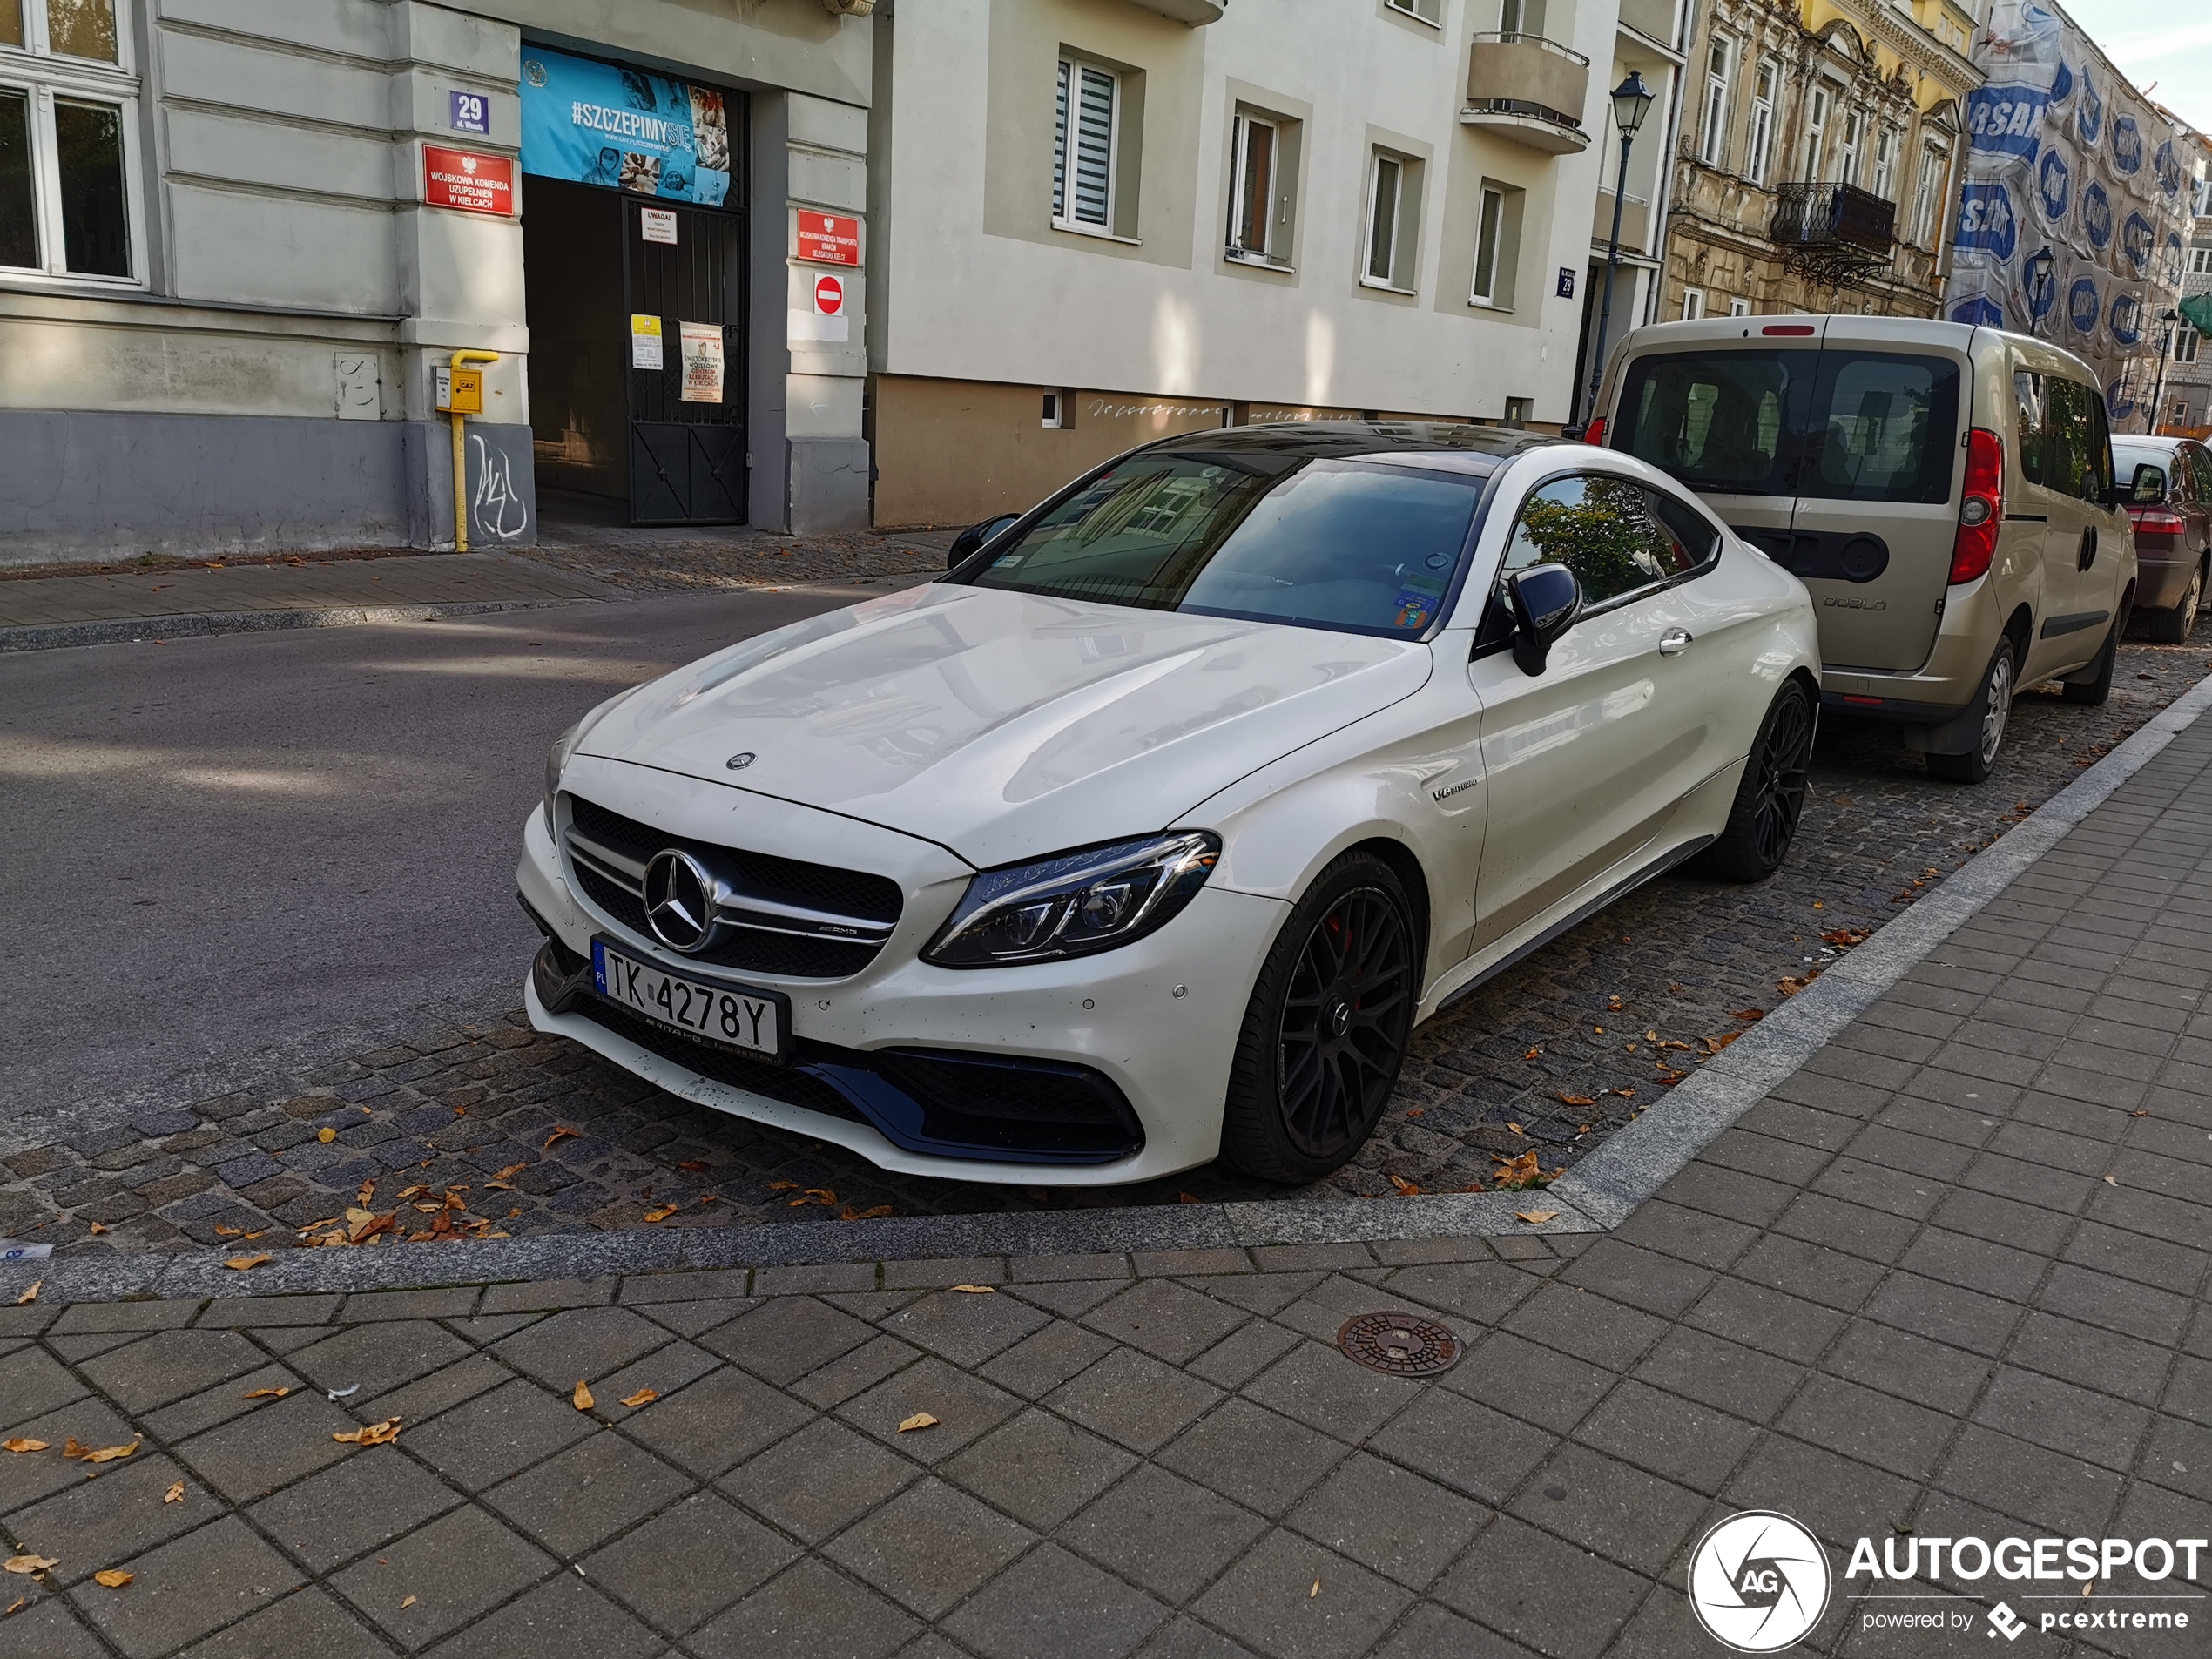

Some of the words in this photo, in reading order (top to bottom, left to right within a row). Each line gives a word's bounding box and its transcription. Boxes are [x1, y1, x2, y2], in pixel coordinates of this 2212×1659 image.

[458, 96, 482, 120] 29
[431, 172, 474, 185] WOJSKOWA
[475, 179, 509, 191] KOMENDA
[449, 185, 493, 199] UZUPEŁNIEŃ
[457, 196, 493, 208] KIELCACH
[1562, 278, 1571, 292] 29
[1433, 786, 1451, 801] V8
[832, 927, 857, 935] AMG
[596, 971, 606, 985] PL
[609, 949, 645, 1008] TK
[657, 977, 765, 1045] 4278Y
